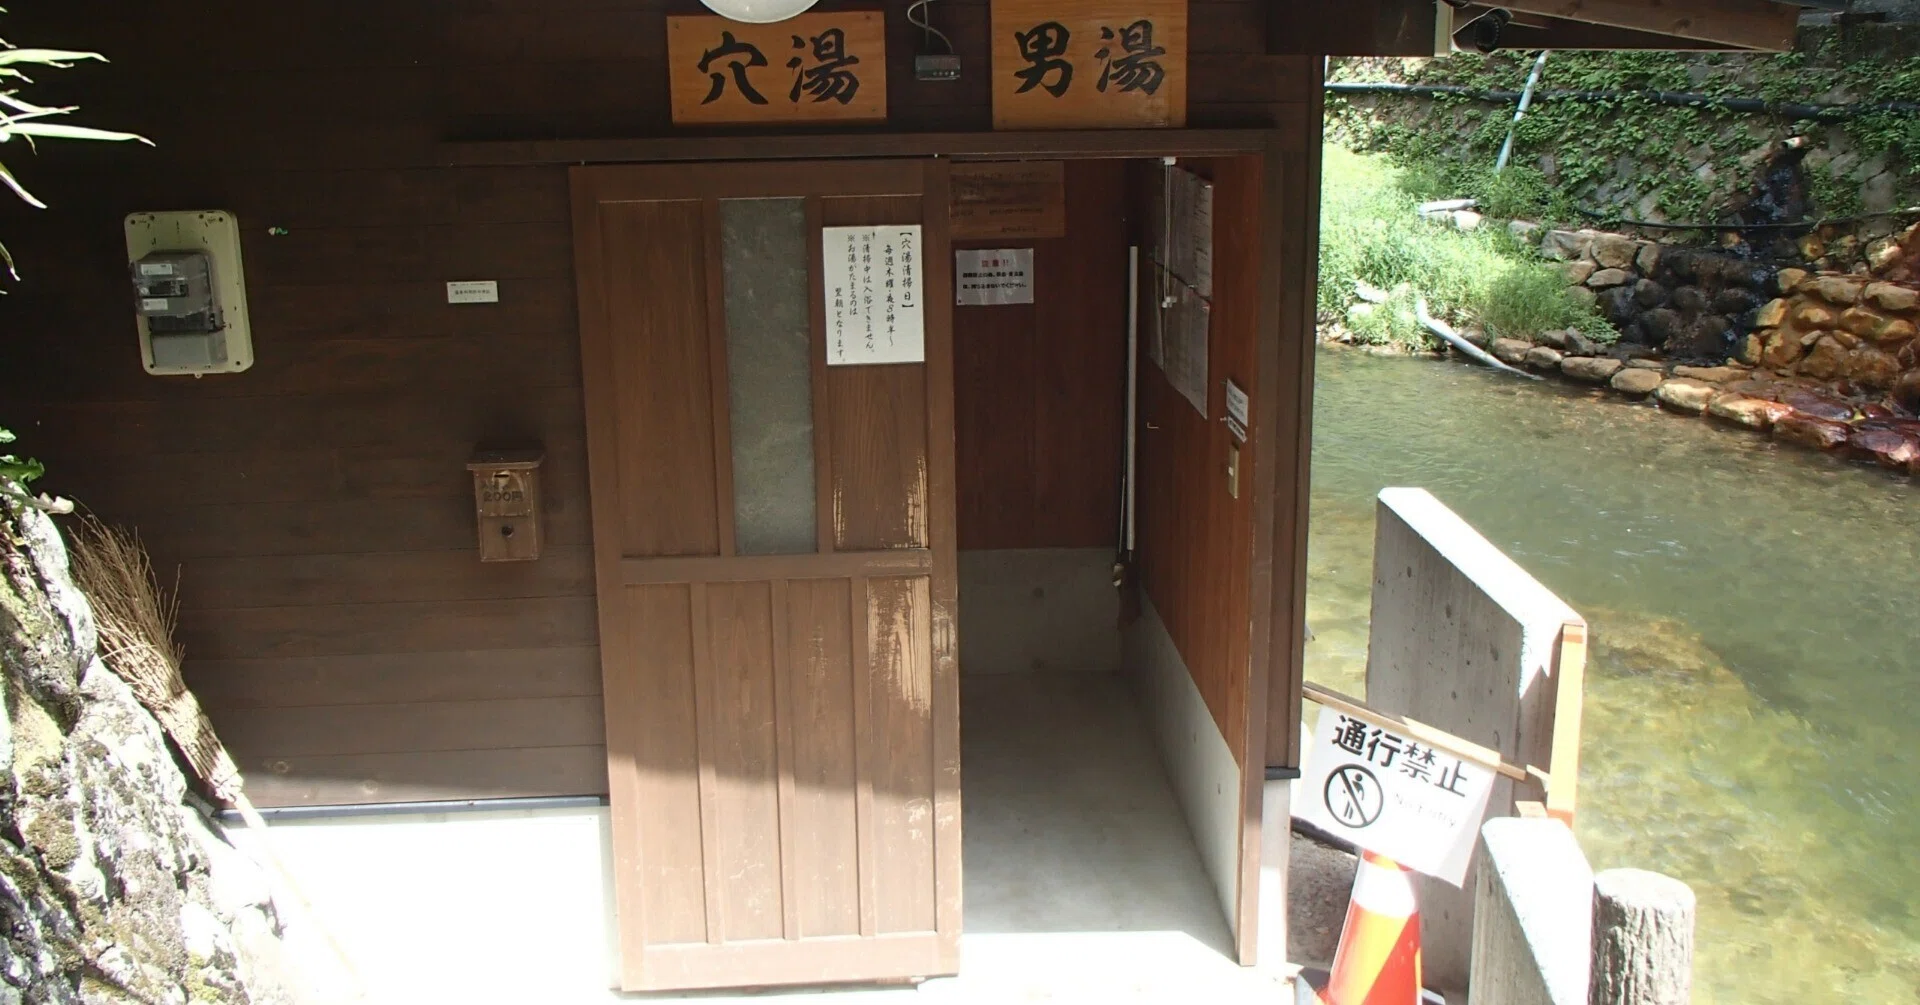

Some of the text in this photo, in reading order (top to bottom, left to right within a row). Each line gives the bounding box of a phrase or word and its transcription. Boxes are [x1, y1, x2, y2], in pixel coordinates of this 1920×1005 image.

[697, 28, 860, 105] 穴湯
[1013, 19, 1166, 98] 男湯
[1331, 714, 1468, 798] 通行禁止
